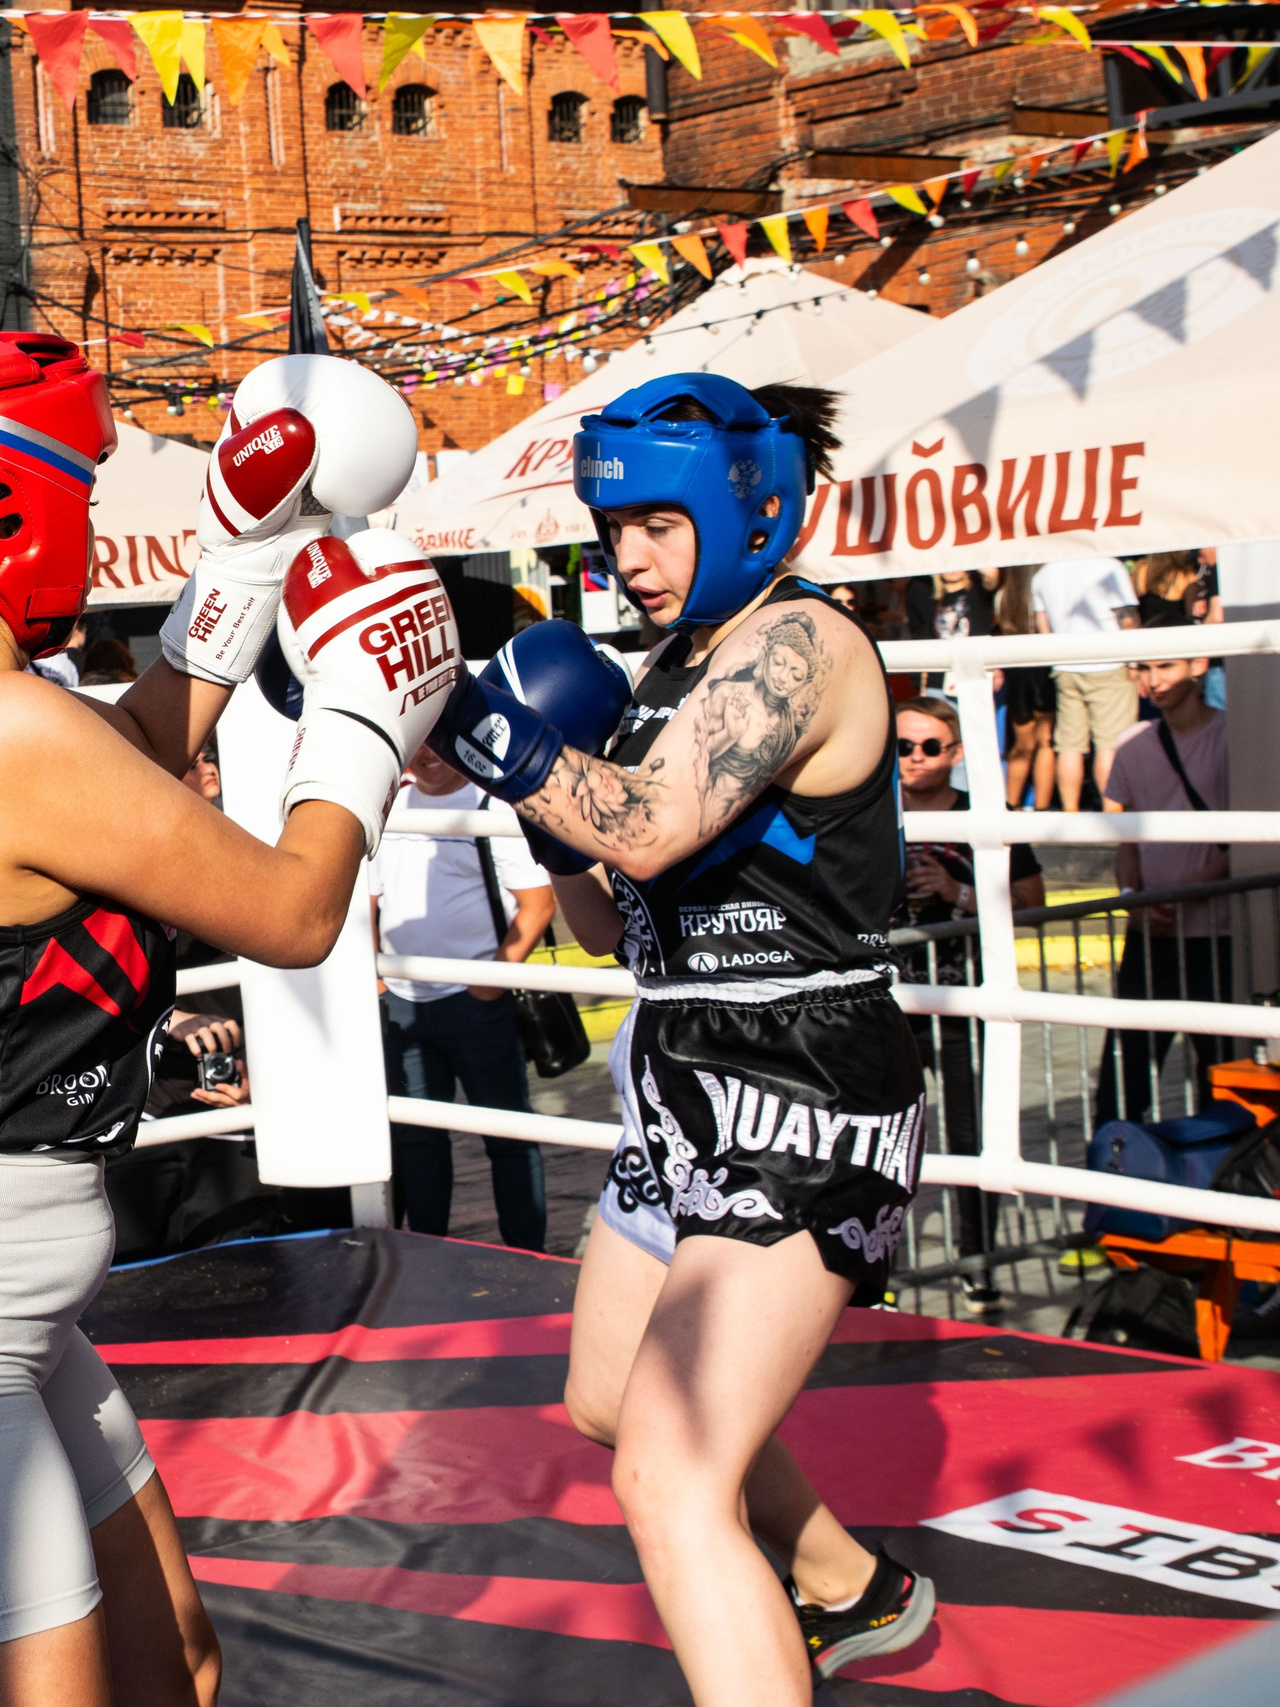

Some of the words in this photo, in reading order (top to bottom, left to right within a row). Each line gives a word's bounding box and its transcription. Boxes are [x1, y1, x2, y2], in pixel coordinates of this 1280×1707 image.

[232, 424, 281, 467] UNIQUE
[580, 456, 624, 480] clinch
[306, 541, 333, 579] UNIQUE
[188, 588, 221, 638] GREEN
[196, 603, 228, 643] HILL
[215, 649, 226, 660] Be
[222, 630, 237, 649] Your
[232, 612, 247, 629] Best
[243, 596, 256, 611] Self
[376, 625, 456, 692] HILL
[678, 908, 787, 938] КРУТОЯР
[721, 950, 795, 968] LADOGA
[66, 1092, 95, 1107] GIN
[1173, 1435, 1280, 1481] B
[988, 1507, 1280, 1594] SIB
